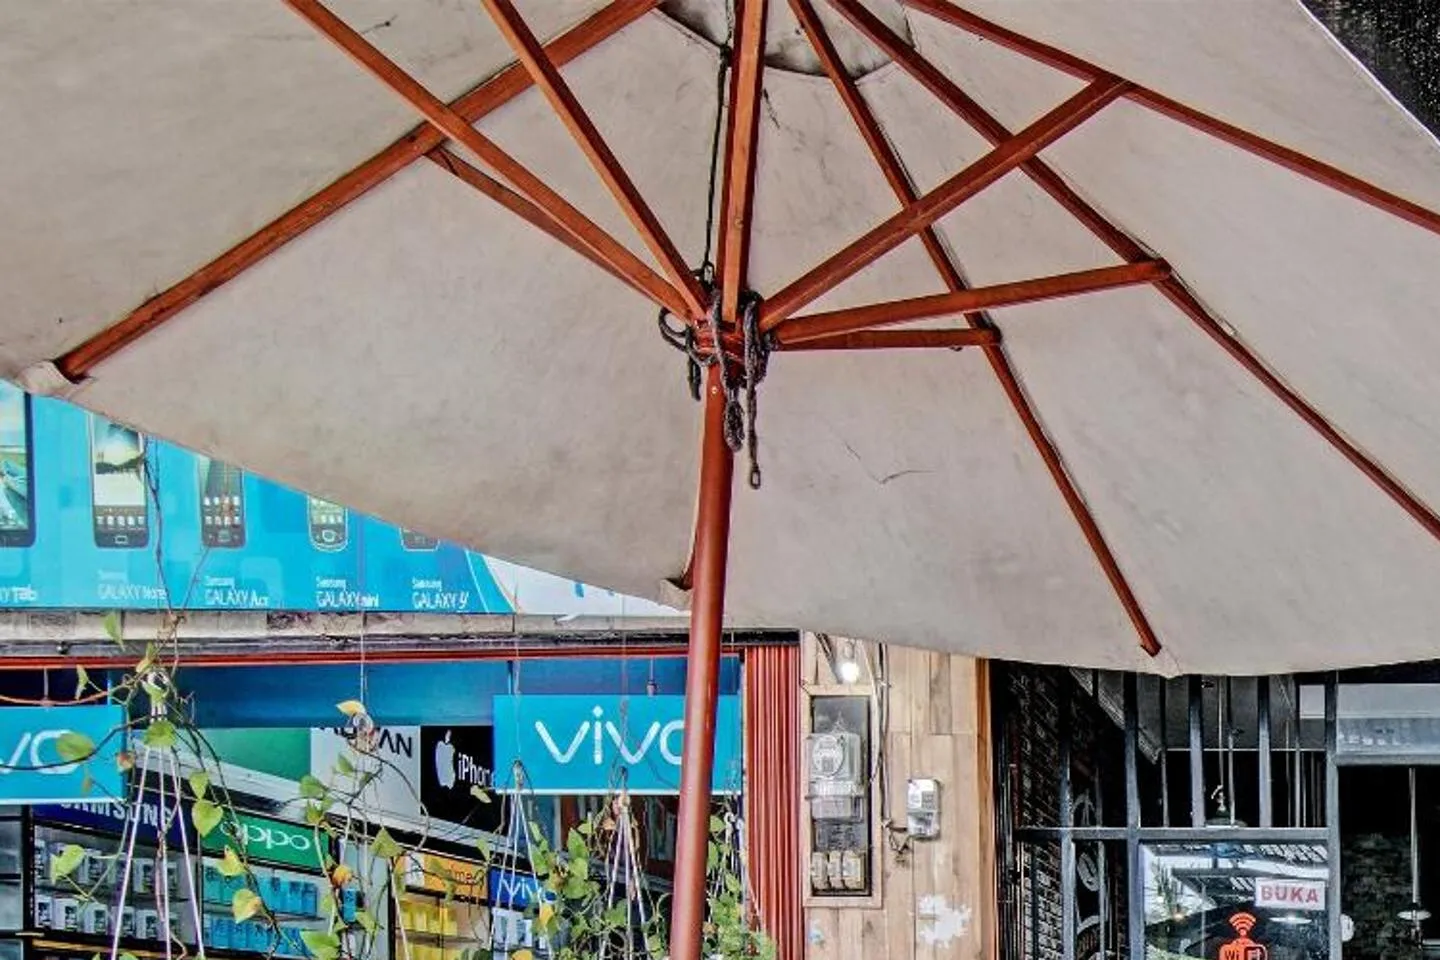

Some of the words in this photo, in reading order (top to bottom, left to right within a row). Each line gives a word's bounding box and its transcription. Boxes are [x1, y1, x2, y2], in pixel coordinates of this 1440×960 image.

[205, 588, 249, 606] GALAXY
[316, 591, 360, 608] GALAXY
[412, 591, 456, 609] GALAXY
[59, 801, 174, 829] MSUNG
[1260, 886, 1320, 904] BUKA
